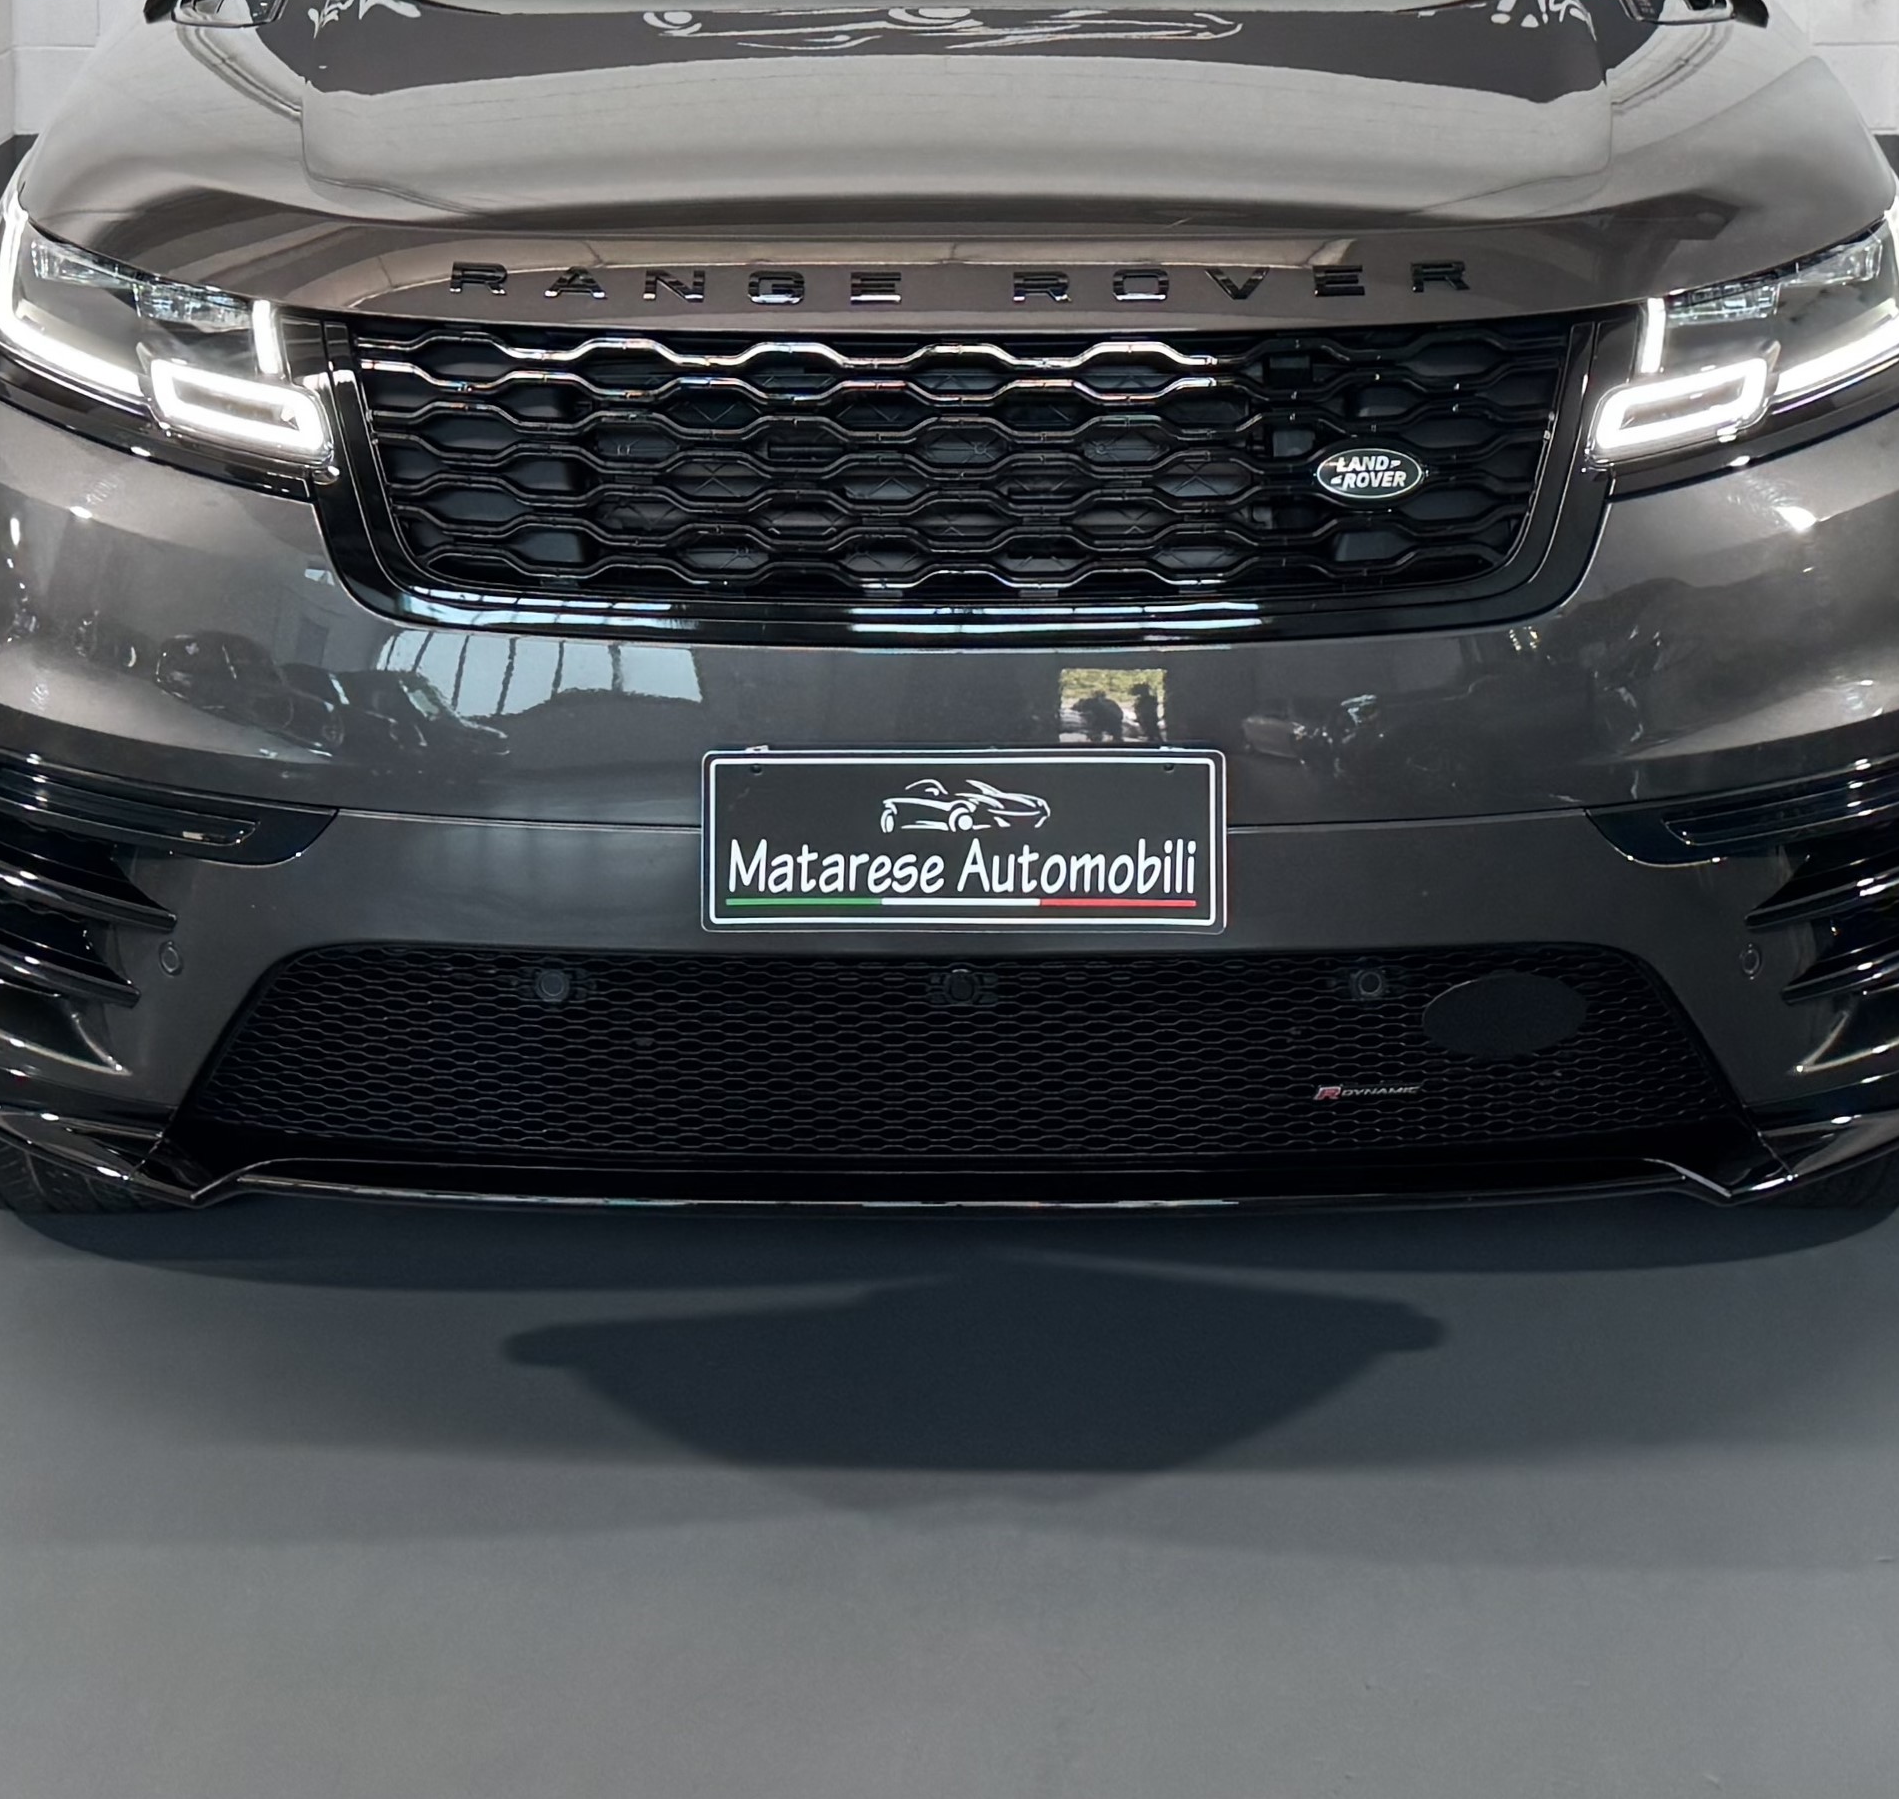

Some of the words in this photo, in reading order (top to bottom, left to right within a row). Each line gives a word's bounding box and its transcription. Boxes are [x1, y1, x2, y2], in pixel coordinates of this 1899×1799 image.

[449, 261, 904, 305] RANGE
[1013, 261, 1470, 302] ROVER
[1335, 455, 1390, 473] LAND
[1341, 470, 1407, 491] ROVER
[727, 838, 946, 895] Matarese
[956, 837, 1198, 895] Automobili
